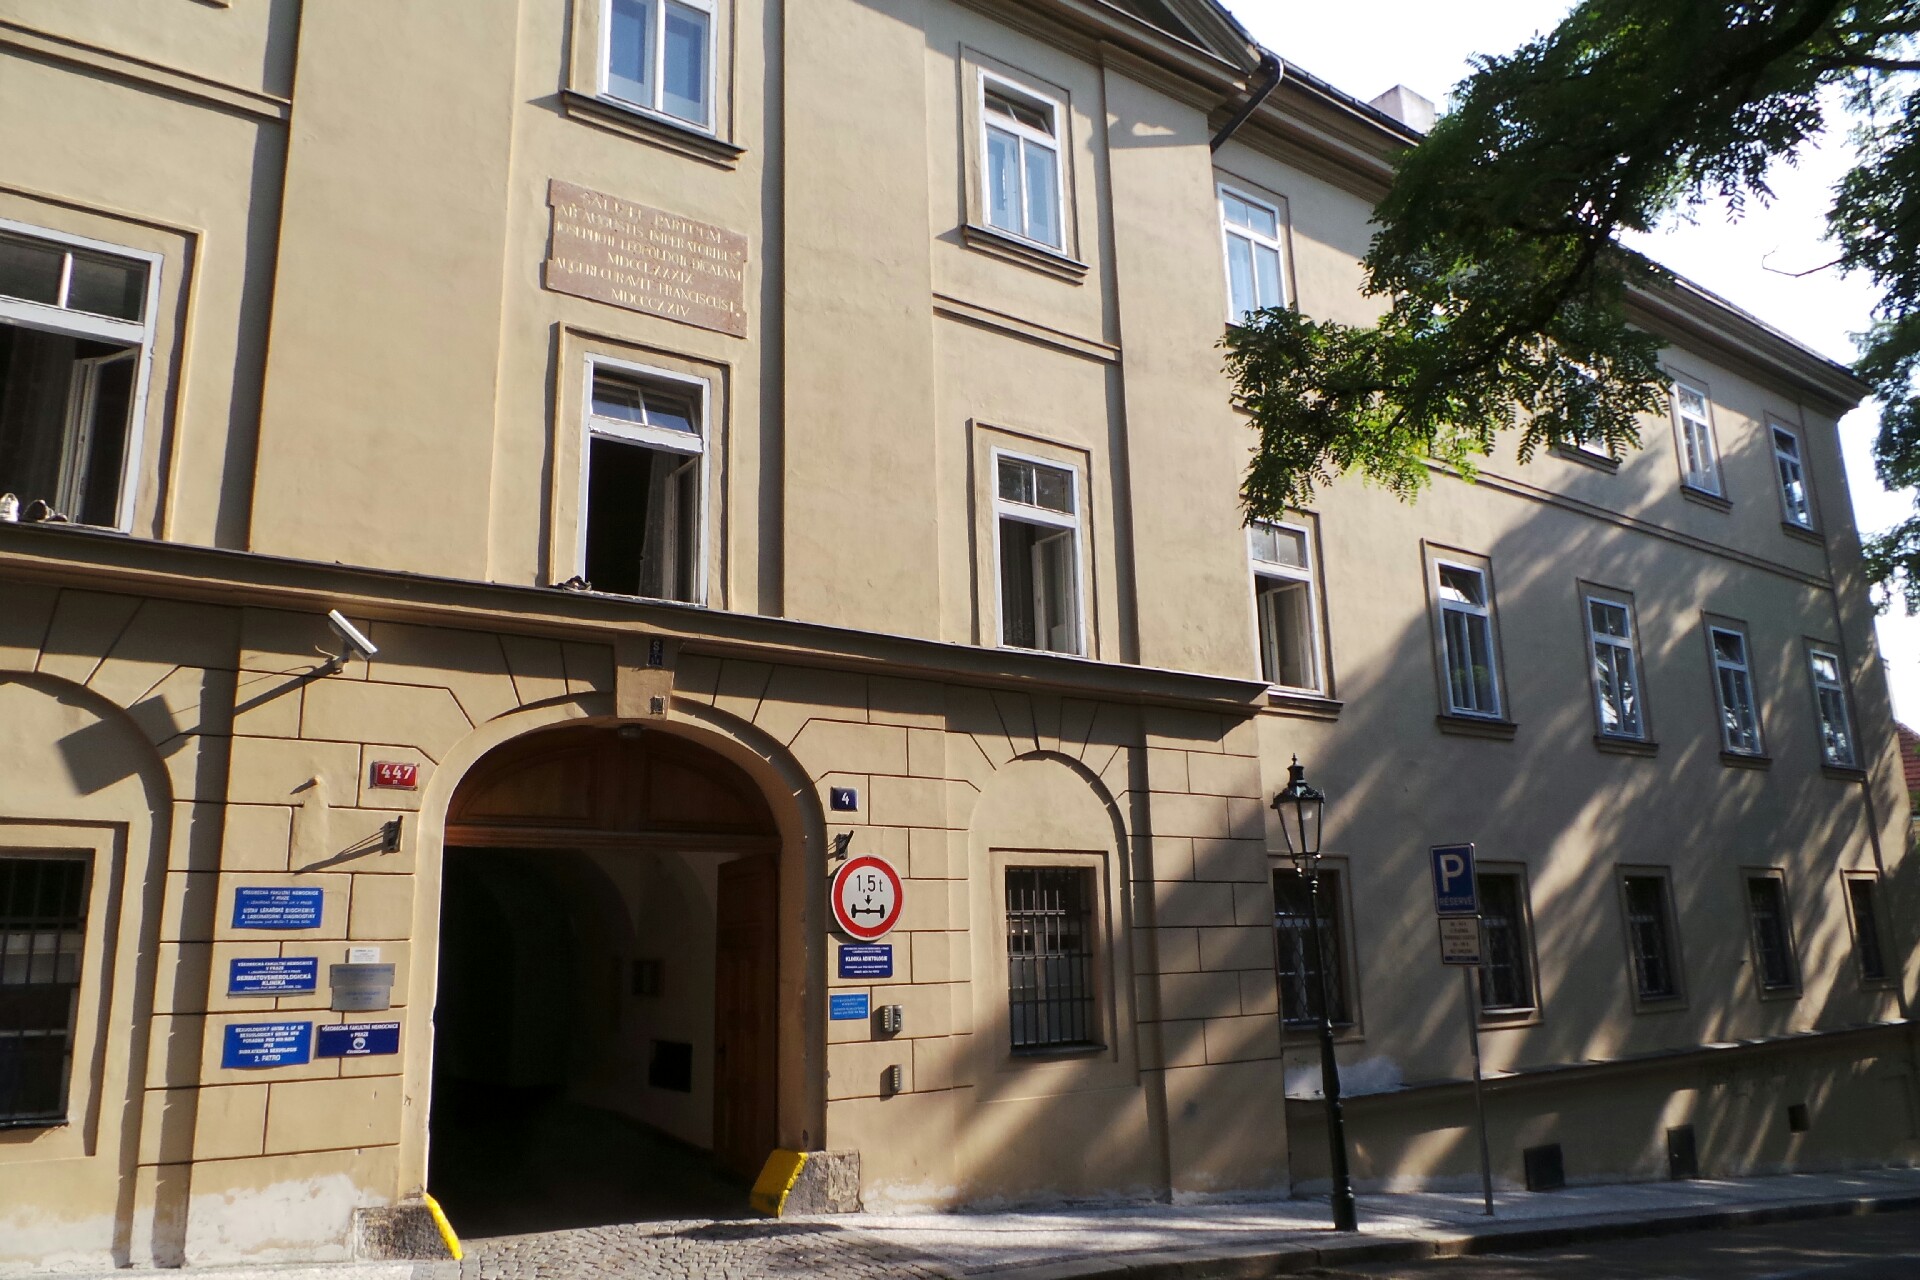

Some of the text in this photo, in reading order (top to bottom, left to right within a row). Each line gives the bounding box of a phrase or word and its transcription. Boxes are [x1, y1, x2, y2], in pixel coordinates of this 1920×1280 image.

[558, 203, 578, 218] AB
[583, 211, 644, 238] AUGUSTIS
[610, 287, 690, 317] MDCCCXXIV
[381, 764, 414, 779] 447
[841, 791, 850, 805] 4
[856, 874, 884, 893] 1,5 t
[1440, 854, 1465, 893] P
